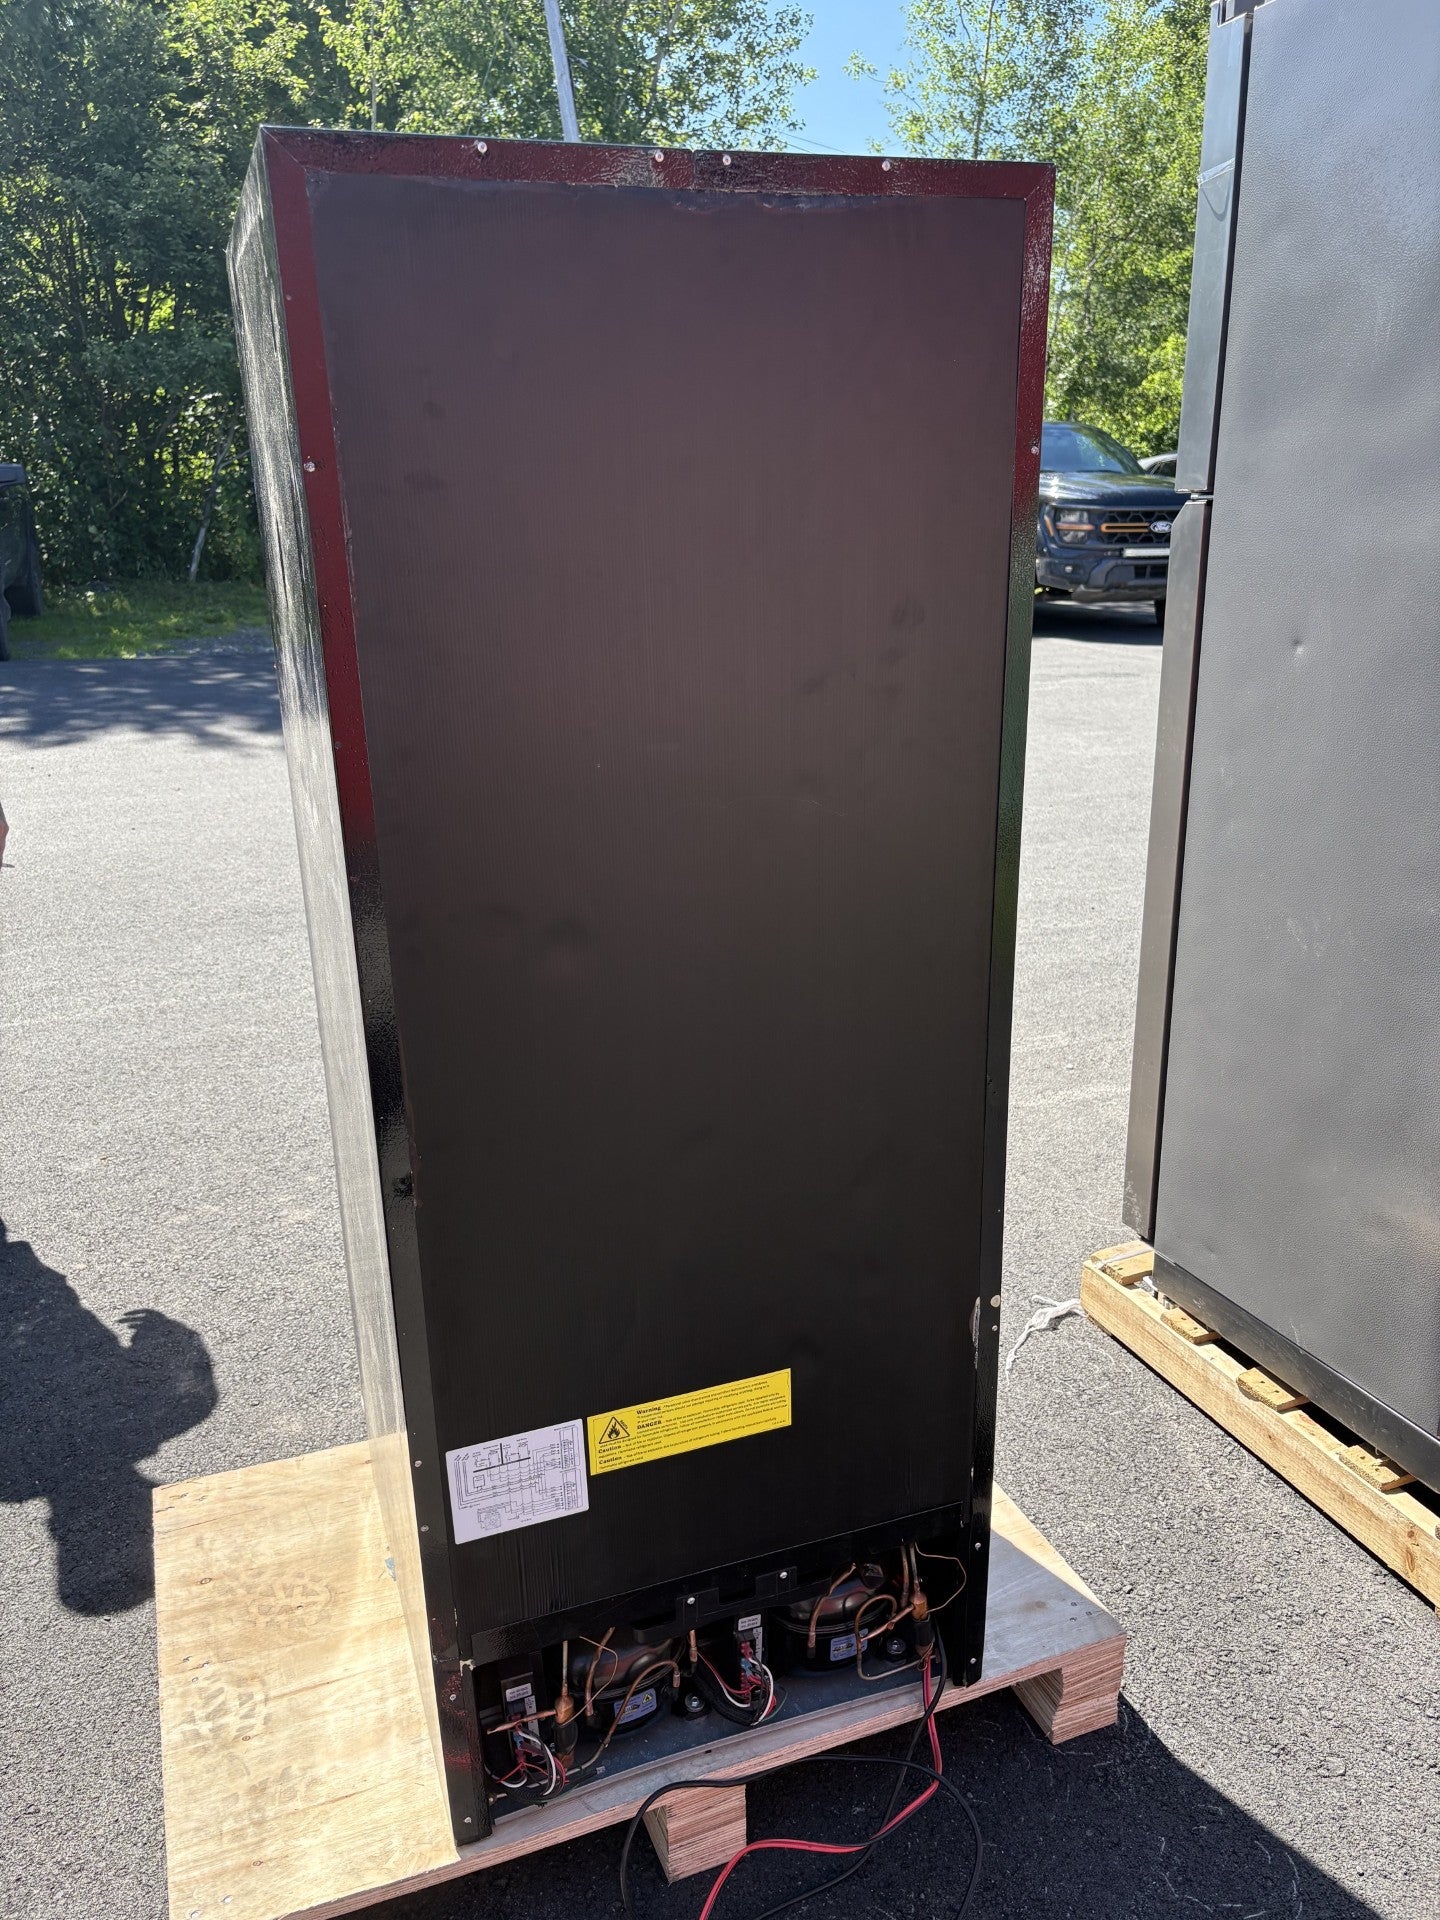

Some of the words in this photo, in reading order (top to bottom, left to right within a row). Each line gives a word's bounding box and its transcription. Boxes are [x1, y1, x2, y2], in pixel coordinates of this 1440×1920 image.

[636, 1406, 662, 1415] Warning
[637, 1420, 662, 1430] DANGER
[598, 1445, 621, 1454] Caution
[598, 1456, 622, 1465] Caution
